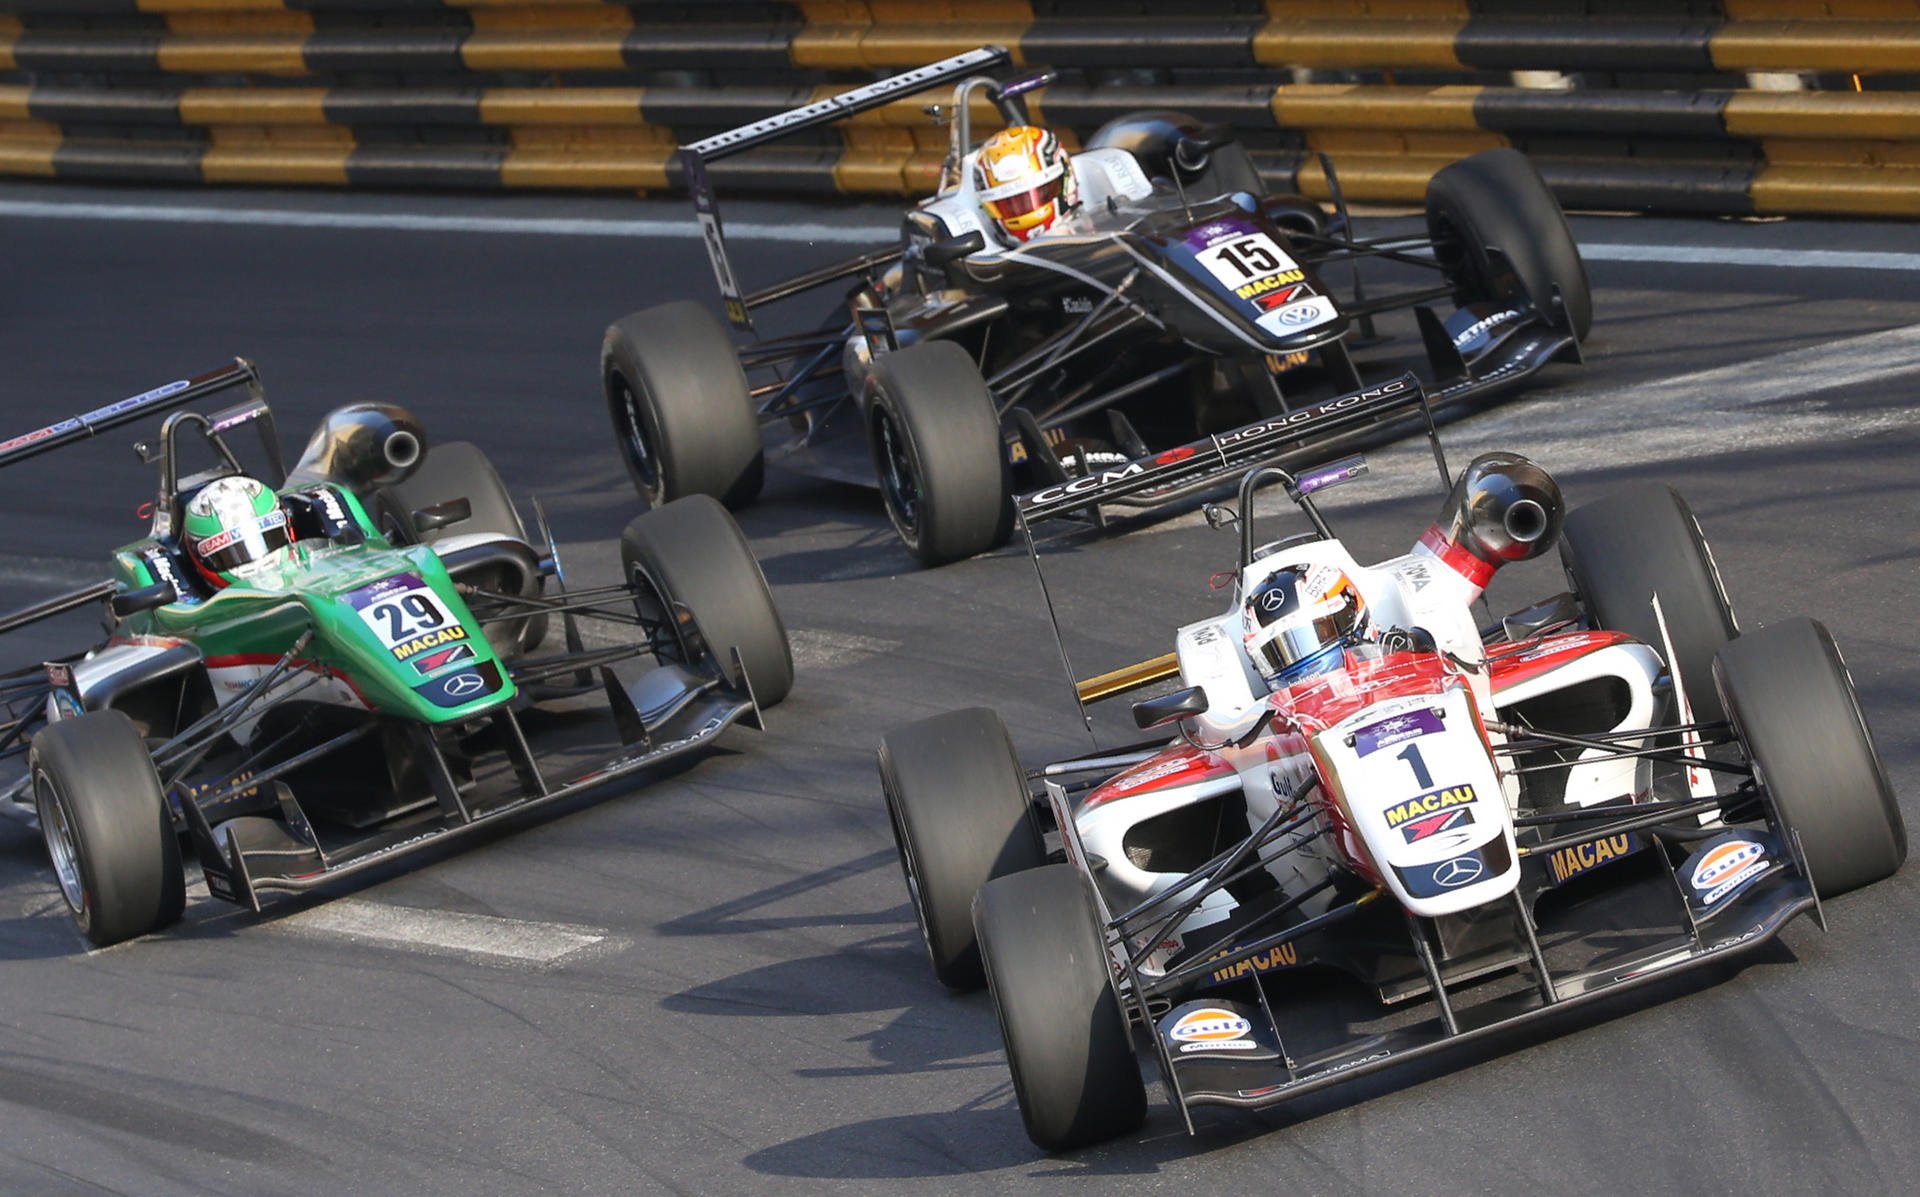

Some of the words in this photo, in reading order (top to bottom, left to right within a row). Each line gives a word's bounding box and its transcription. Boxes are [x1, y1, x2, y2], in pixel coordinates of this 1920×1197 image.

[1215, 239, 1281, 279] 15
[1235, 269, 1306, 300] MACAU
[1031, 462, 1145, 504] CCM
[1219, 410, 1312, 446] HONG
[1318, 381, 1407, 413] KONG
[374, 593, 444, 642] 29
[393, 625, 466, 661] MACAU
[1396, 742, 1435, 790] 1
[1385, 785, 1475, 827] MACAU
[1551, 832, 1629, 883] MACAU
[1696, 842, 1765, 885] Gulf
[1176, 1019, 1250, 1036] Gulf
